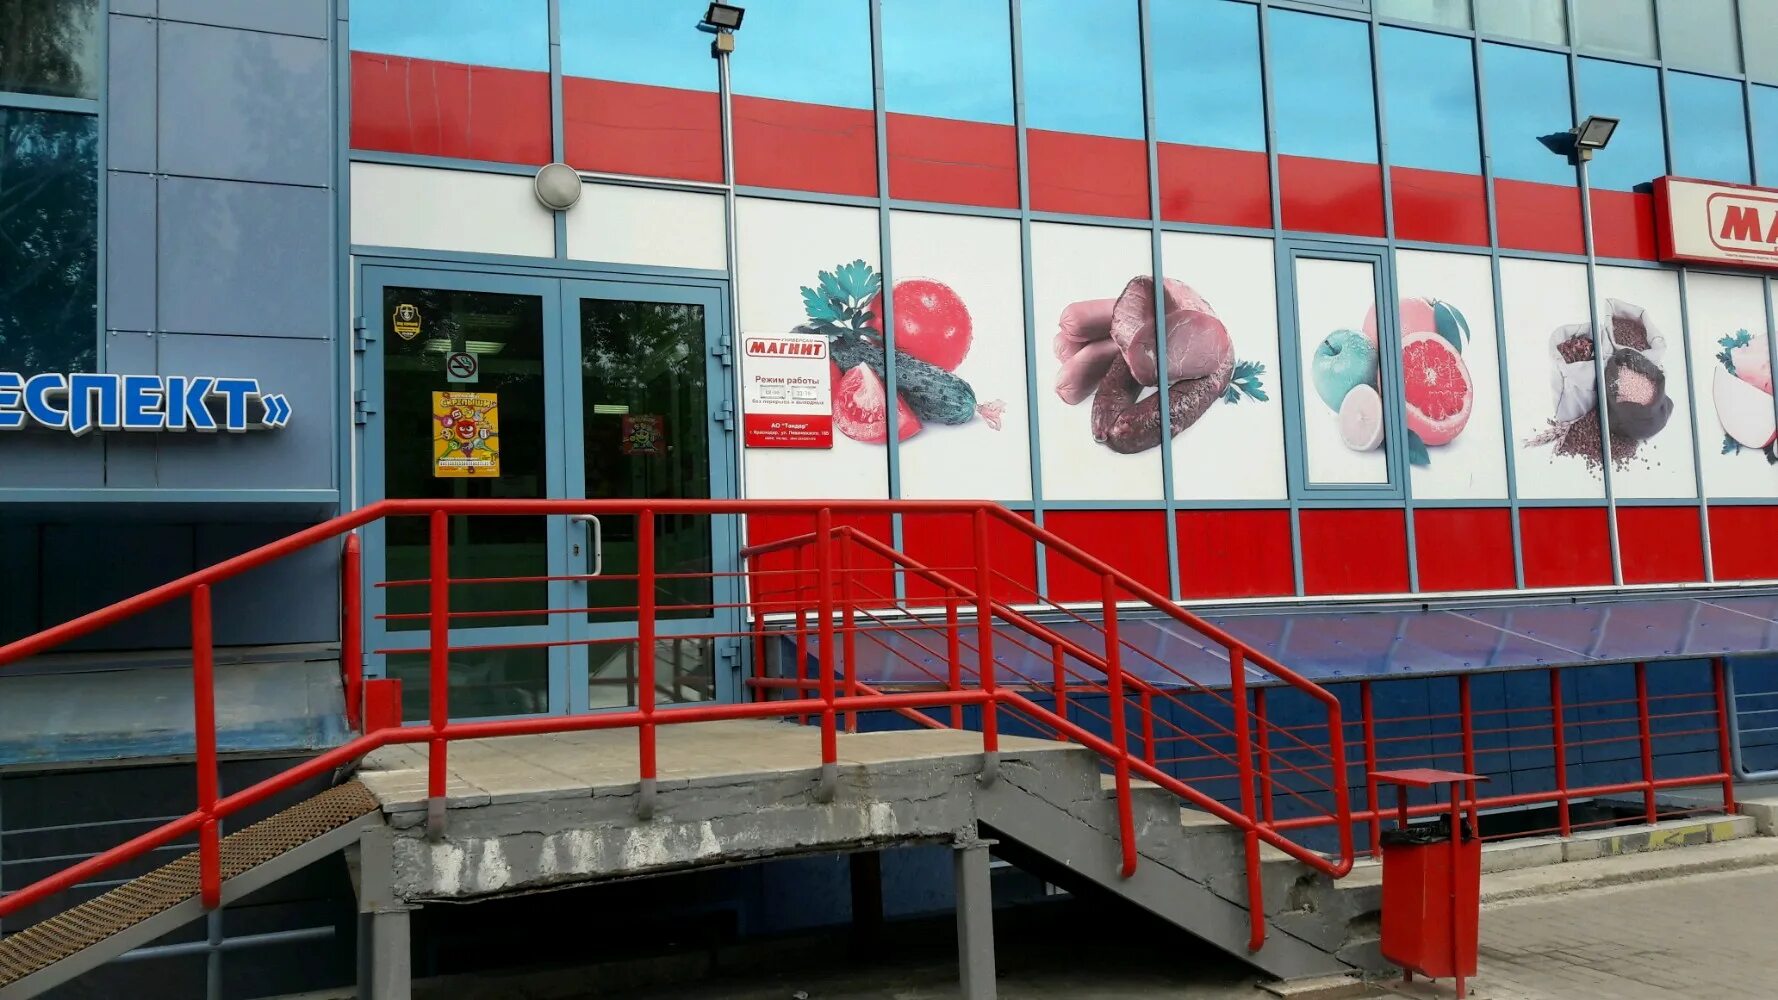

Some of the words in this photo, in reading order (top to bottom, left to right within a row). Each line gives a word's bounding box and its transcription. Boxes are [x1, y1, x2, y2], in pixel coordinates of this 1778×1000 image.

[750, 341, 822, 356] МАГНИТ
[755, 375, 785, 384] Режим
[787, 377, 820, 385] работы
